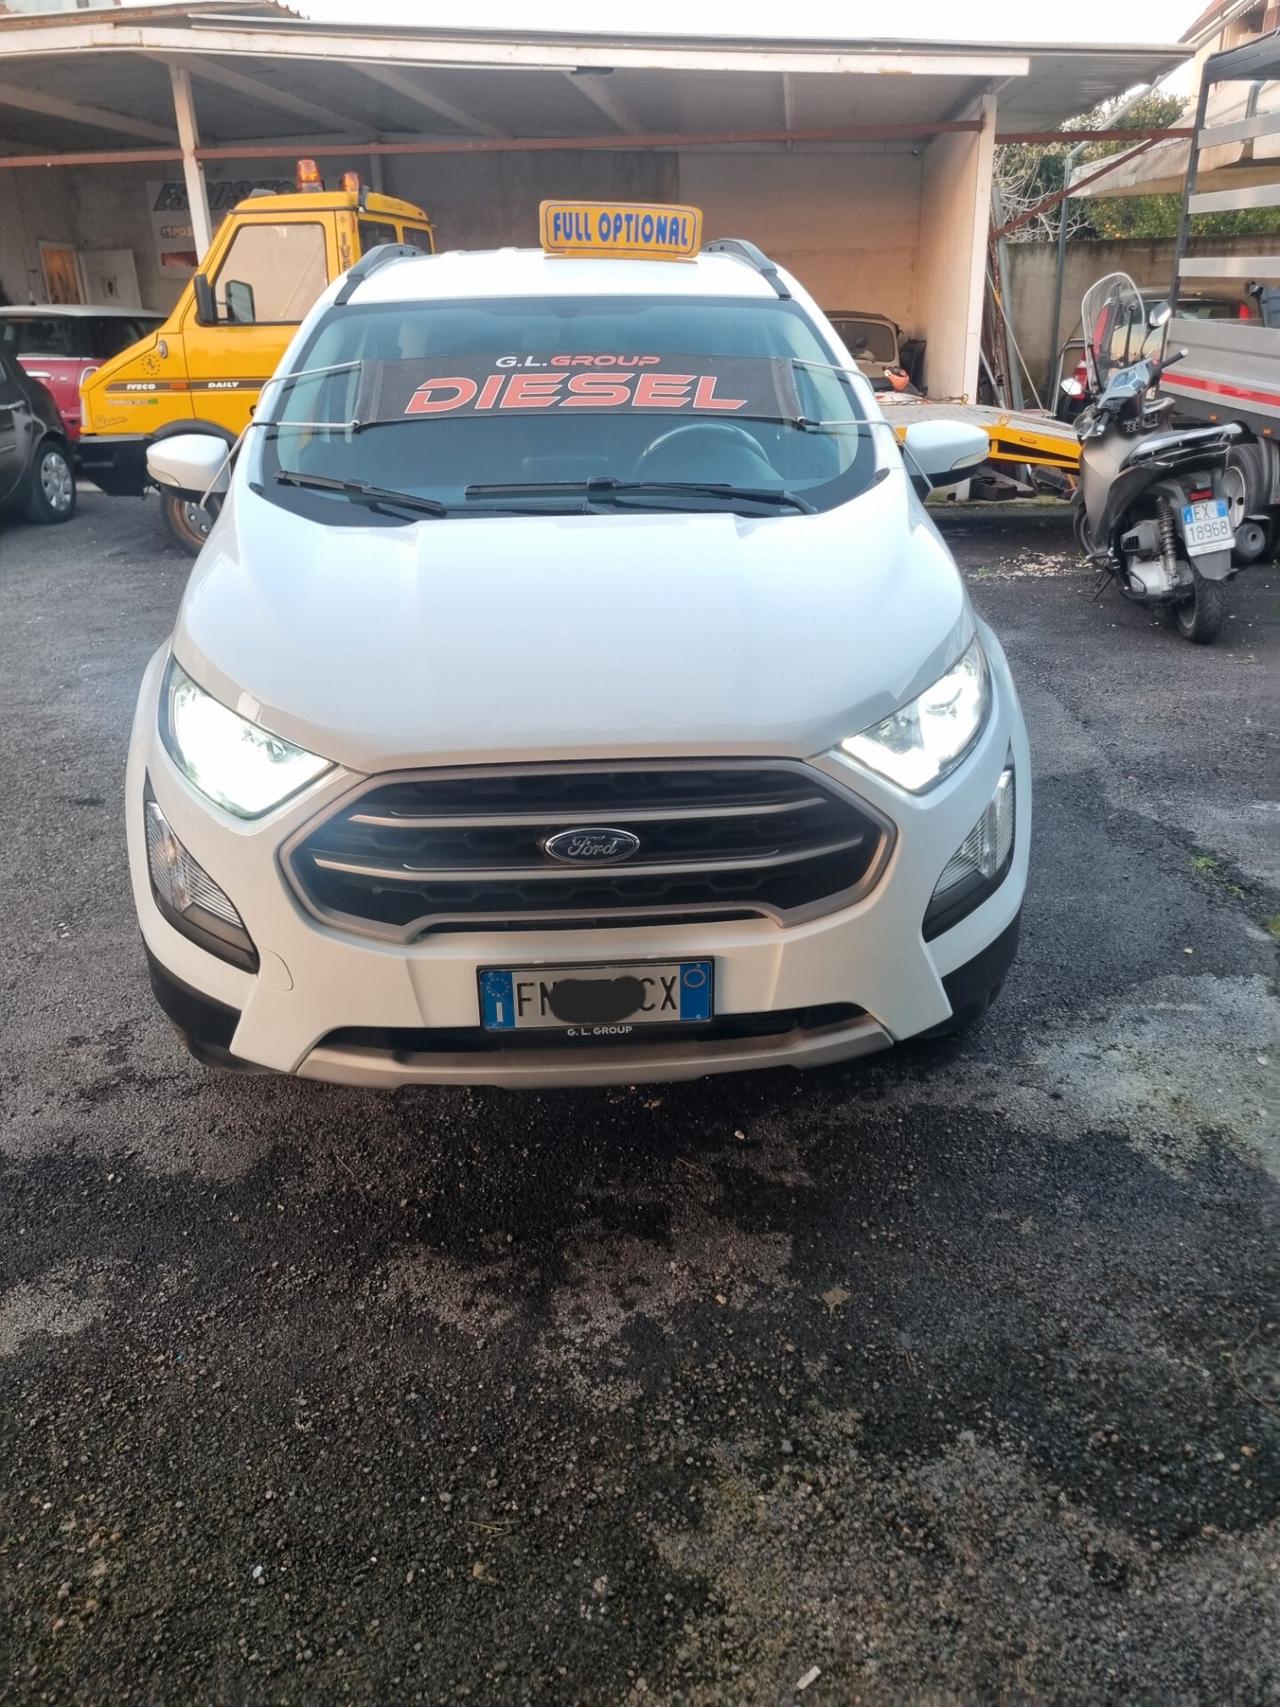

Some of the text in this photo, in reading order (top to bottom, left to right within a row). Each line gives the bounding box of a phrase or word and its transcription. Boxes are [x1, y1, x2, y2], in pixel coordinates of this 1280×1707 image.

[553, 212, 688, 246] FULL OPTIONAL
[126, 383, 156, 391] IVECO
[207, 381, 239, 389] DAILY
[403, 372, 748, 414] DIESEL
[1194, 503, 1210, 520] EX
[1189, 520, 1229, 542] 18968
[567, 835, 622, 856] Ford
[593, 1025, 633, 1036] GROUP
